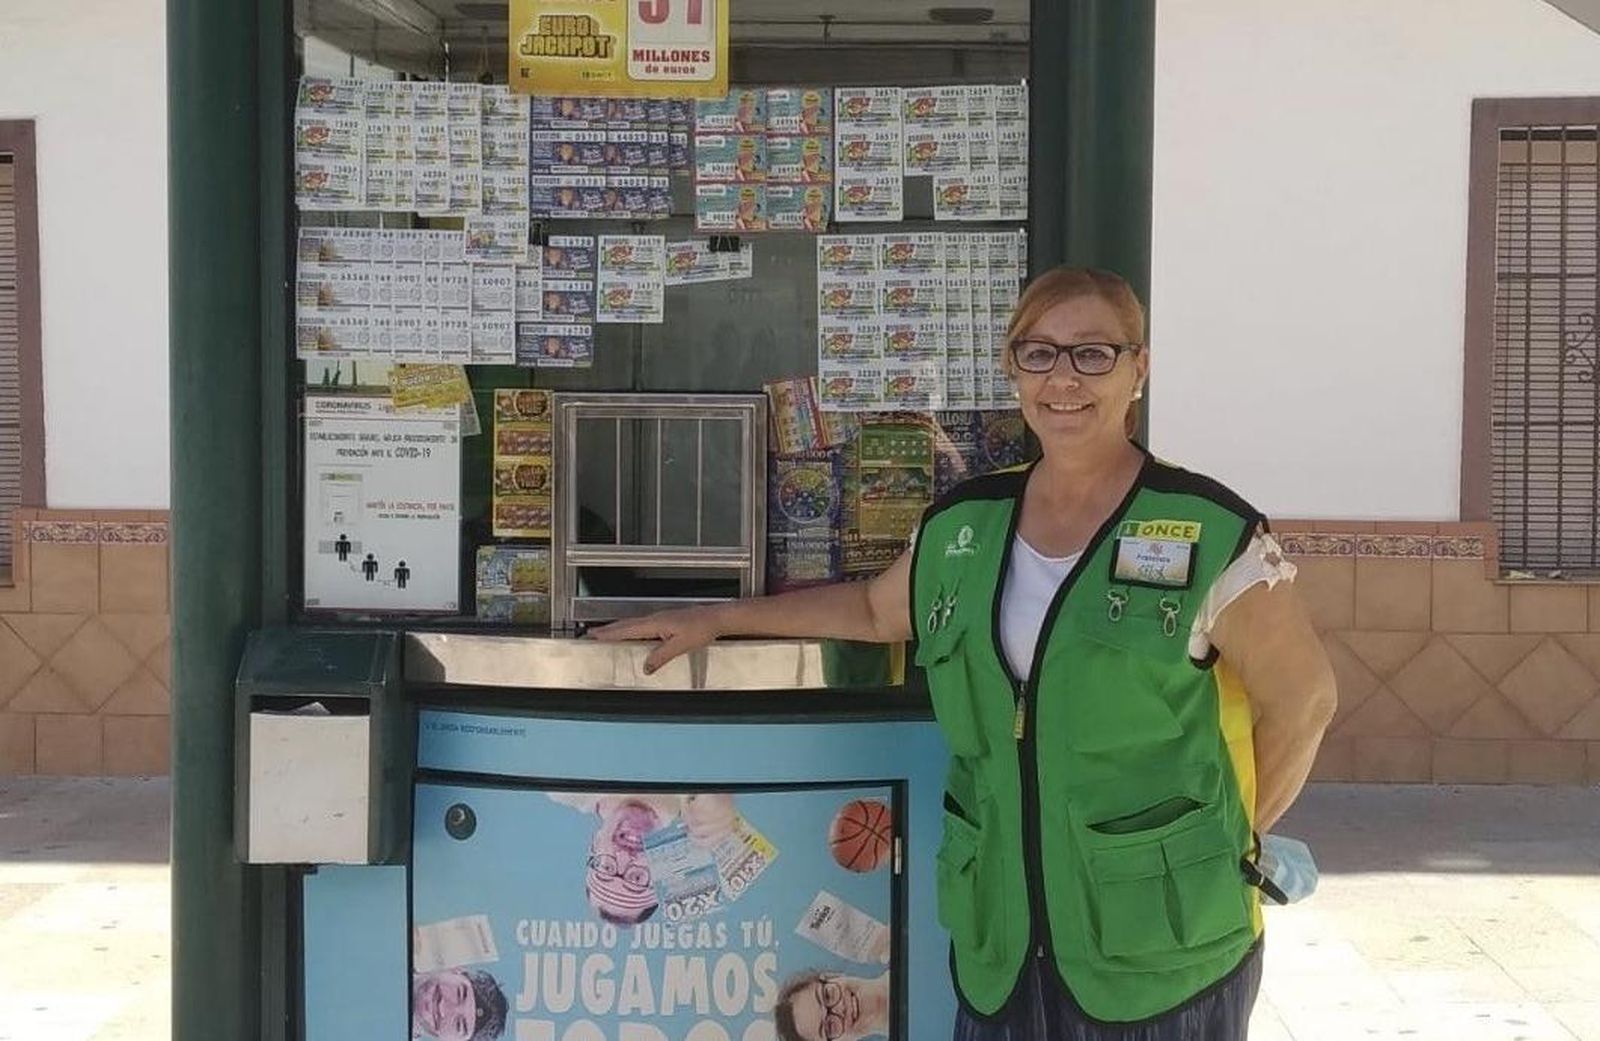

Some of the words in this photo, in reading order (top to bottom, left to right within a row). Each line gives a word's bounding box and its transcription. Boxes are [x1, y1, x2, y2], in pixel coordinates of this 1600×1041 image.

[539, 15, 593, 36] EURO
[521, 35, 614, 58] JACKPOT
[633, 49, 710, 63] MILLONES
[645, 64, 656, 74] de
[663, 66, 696, 74] euros
[394, 447, 431, 459] COVID-19
[1142, 524, 1195, 539] ONCE
[516, 919, 617, 949] CUANDO
[630, 919, 728, 949] JUEGAS
[516, 951, 780, 1017] JUGAMOS
